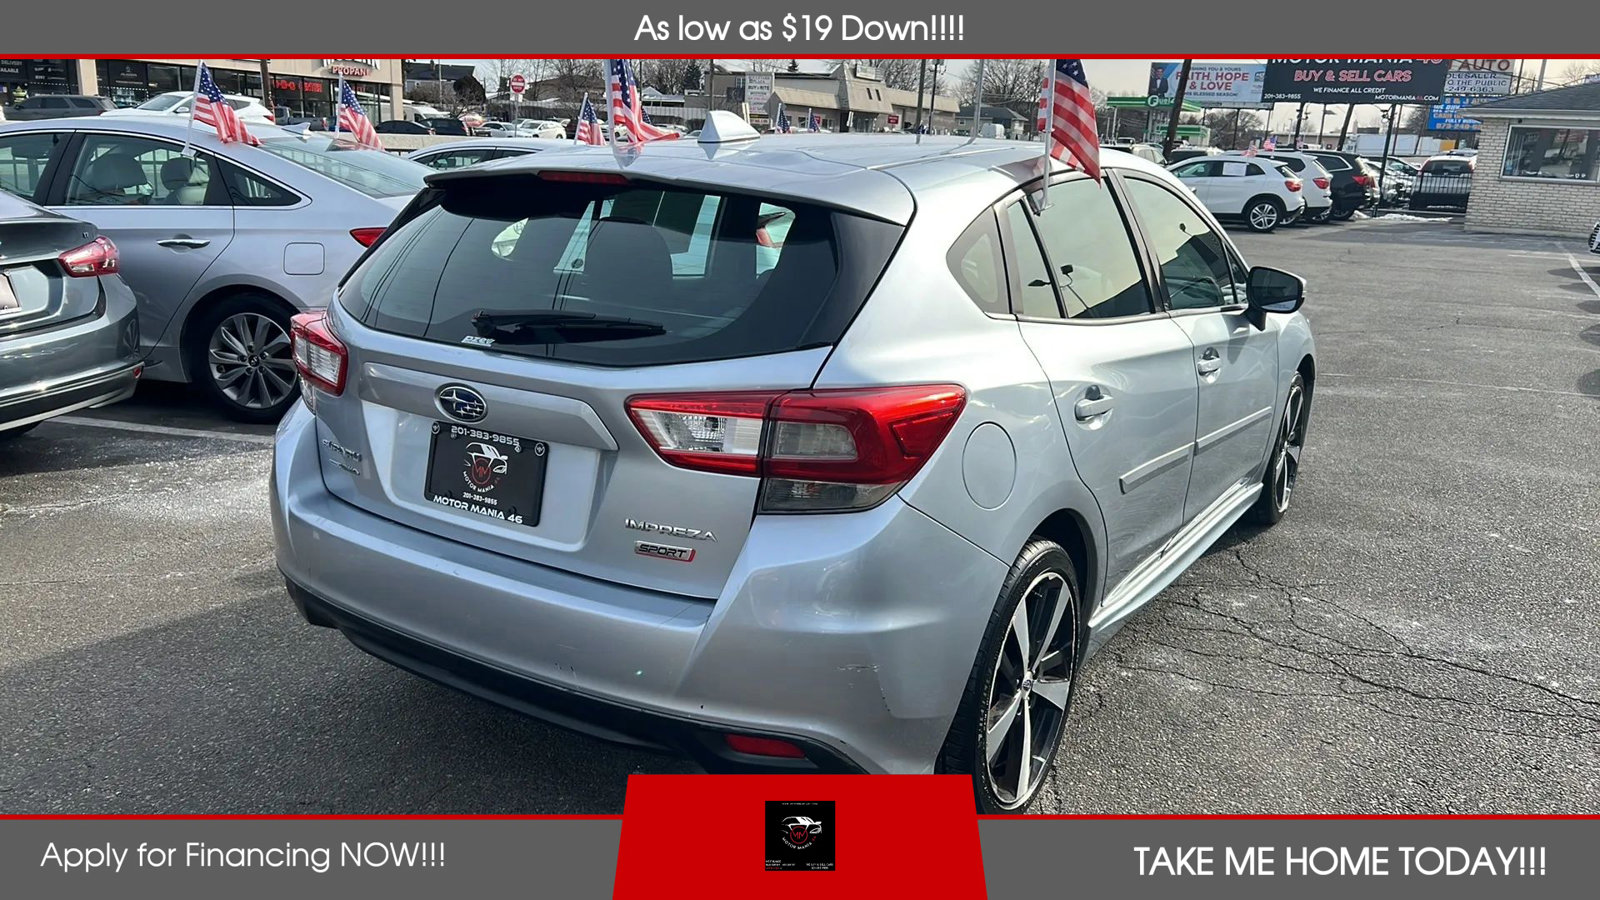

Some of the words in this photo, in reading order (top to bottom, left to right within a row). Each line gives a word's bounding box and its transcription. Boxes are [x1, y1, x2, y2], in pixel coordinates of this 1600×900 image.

[1459, 59, 1510, 71] AUTO
[1176, 71, 1212, 81] FITH,
[1215, 71, 1250, 82] HOPE
[1293, 69, 1324, 82] BUY
[1325, 69, 1336, 82] &
[1338, 69, 1371, 82] SELL
[1373, 69, 1413, 82] CARS
[1200, 81, 1232, 91] LOVE
[451, 425, 520, 448] 201-383-9855
[433, 495, 469, 512] MOTOR
[470, 503, 505, 520] MANIA
[507, 513, 523, 524] 46
[625, 518, 718, 543] IMPREZA
[638, 543, 688, 558] SPORT
